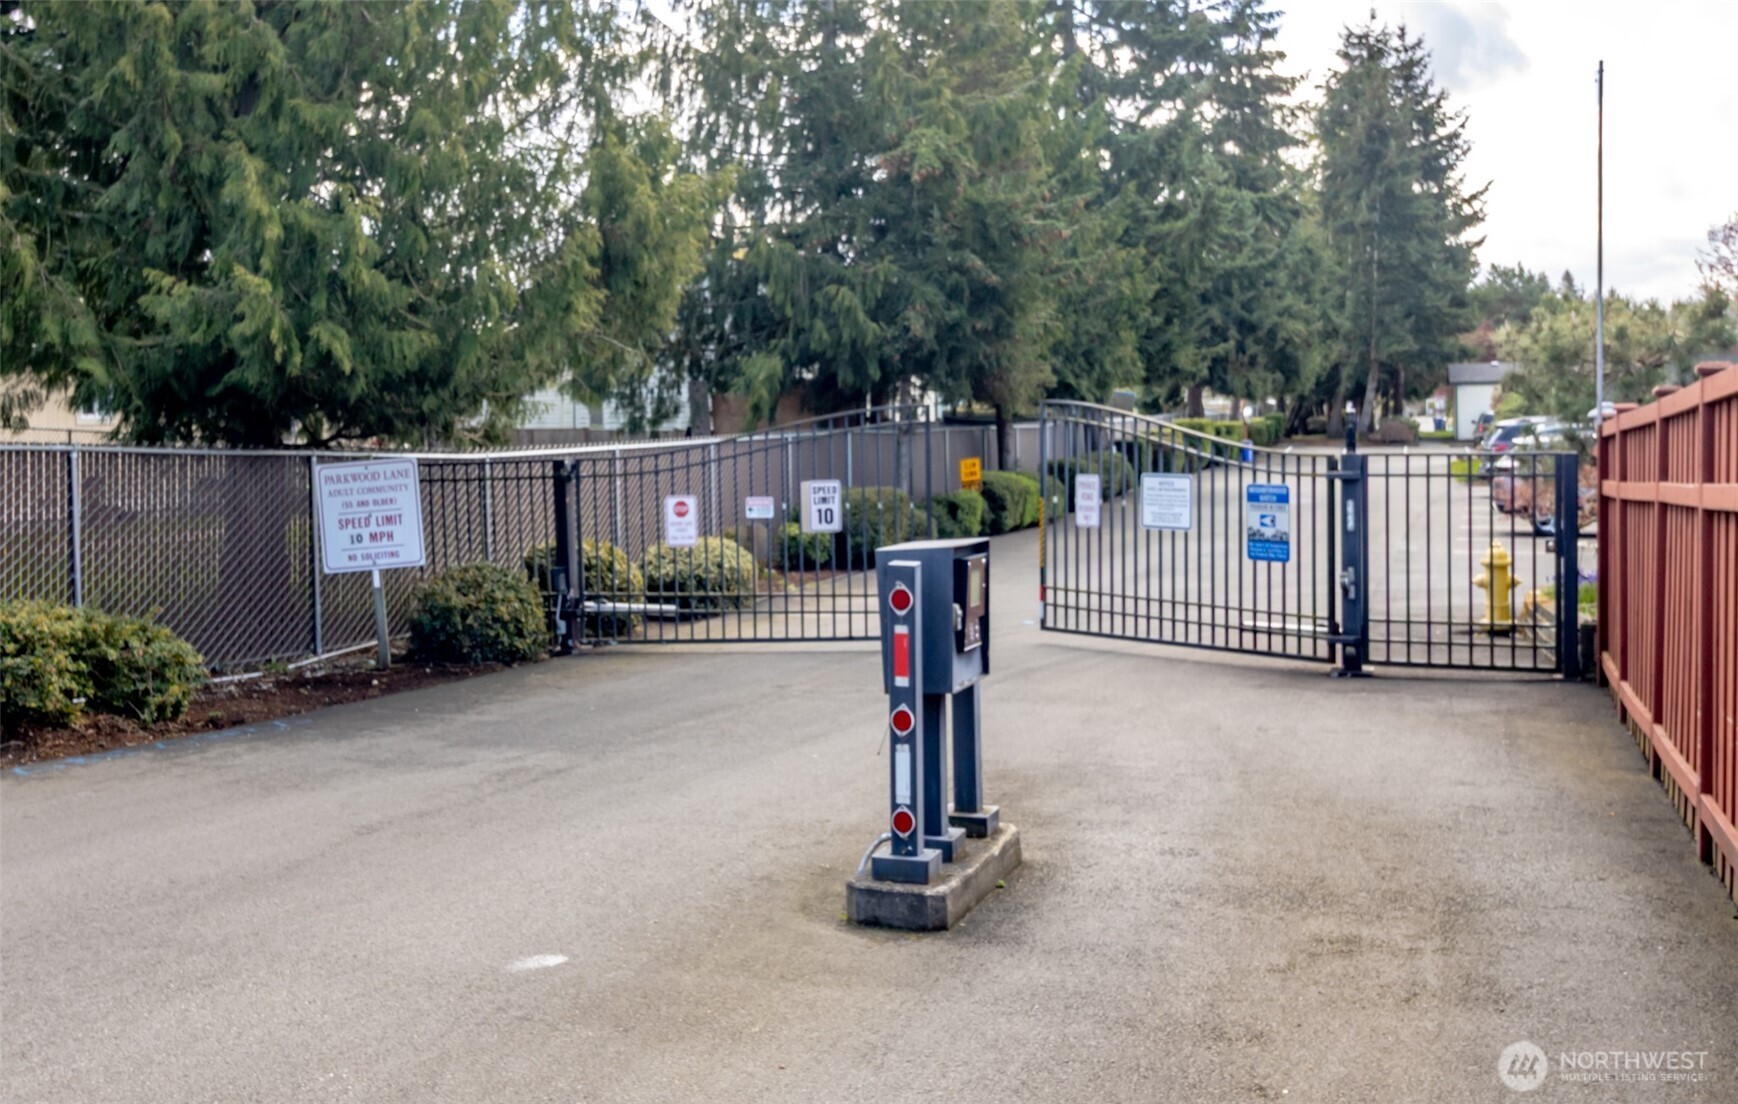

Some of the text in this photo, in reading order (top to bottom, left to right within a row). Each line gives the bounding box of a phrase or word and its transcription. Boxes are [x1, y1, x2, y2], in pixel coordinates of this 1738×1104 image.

[324, 468, 410, 485] PARKWOOD LANE
[327, 483, 409, 498] ADULT COMMUNITY
[812, 485, 837, 495] SPEED
[356, 498, 370, 507] AND
[372, 497, 397, 507] OLDER)
[813, 495, 836, 505] LIMIT
[338, 513, 403, 530] SPEED LIMIT
[816, 508, 834, 525] 10
[350, 530, 394, 545] 10 MPH
[348, 550, 400, 562] NO SOLICITING
